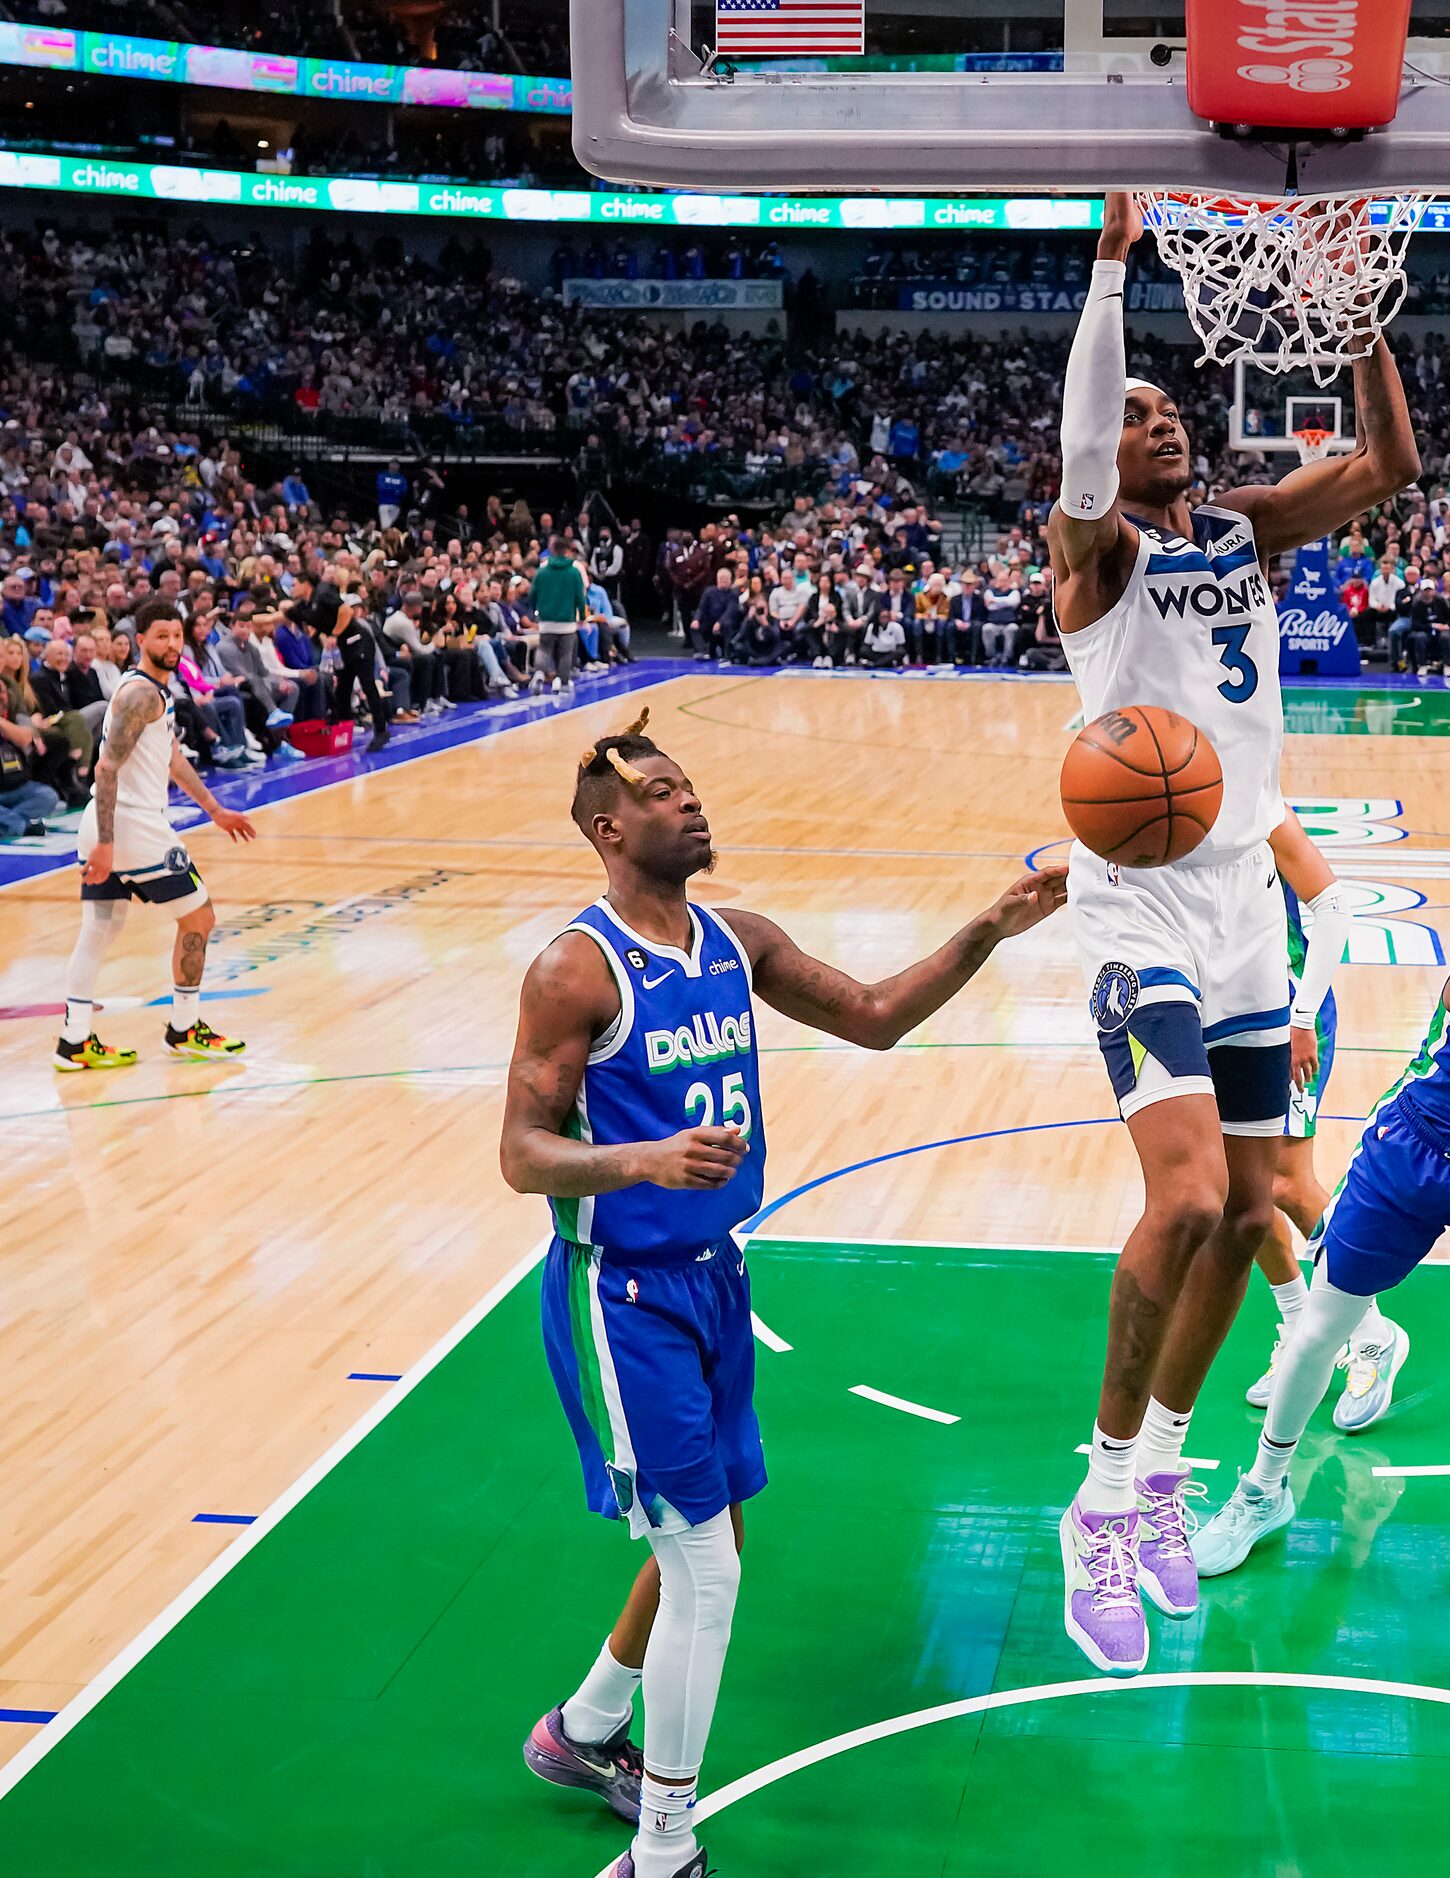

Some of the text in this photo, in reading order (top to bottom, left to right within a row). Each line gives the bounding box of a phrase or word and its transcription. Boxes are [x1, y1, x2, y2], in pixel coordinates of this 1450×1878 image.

[91, 40, 173, 75] chime
[312, 67, 392, 96] chime
[73, 166, 139, 190] chime
[252, 180, 317, 203] chime
[430, 190, 493, 213] chime
[601, 198, 663, 219] chime
[770, 203, 830, 223] chime
[935, 204, 995, 224] chime
[911, 290, 1000, 310] SOUND
[1147, 572, 1266, 620] WOLVES
[1279, 608, 1349, 646] Bally
[1288, 637, 1330, 651] SPORTS
[1211, 622, 1259, 704] 3
[627, 950, 644, 969] 6
[708, 957, 739, 977] chime
[644, 1011, 750, 1075] Dallas
